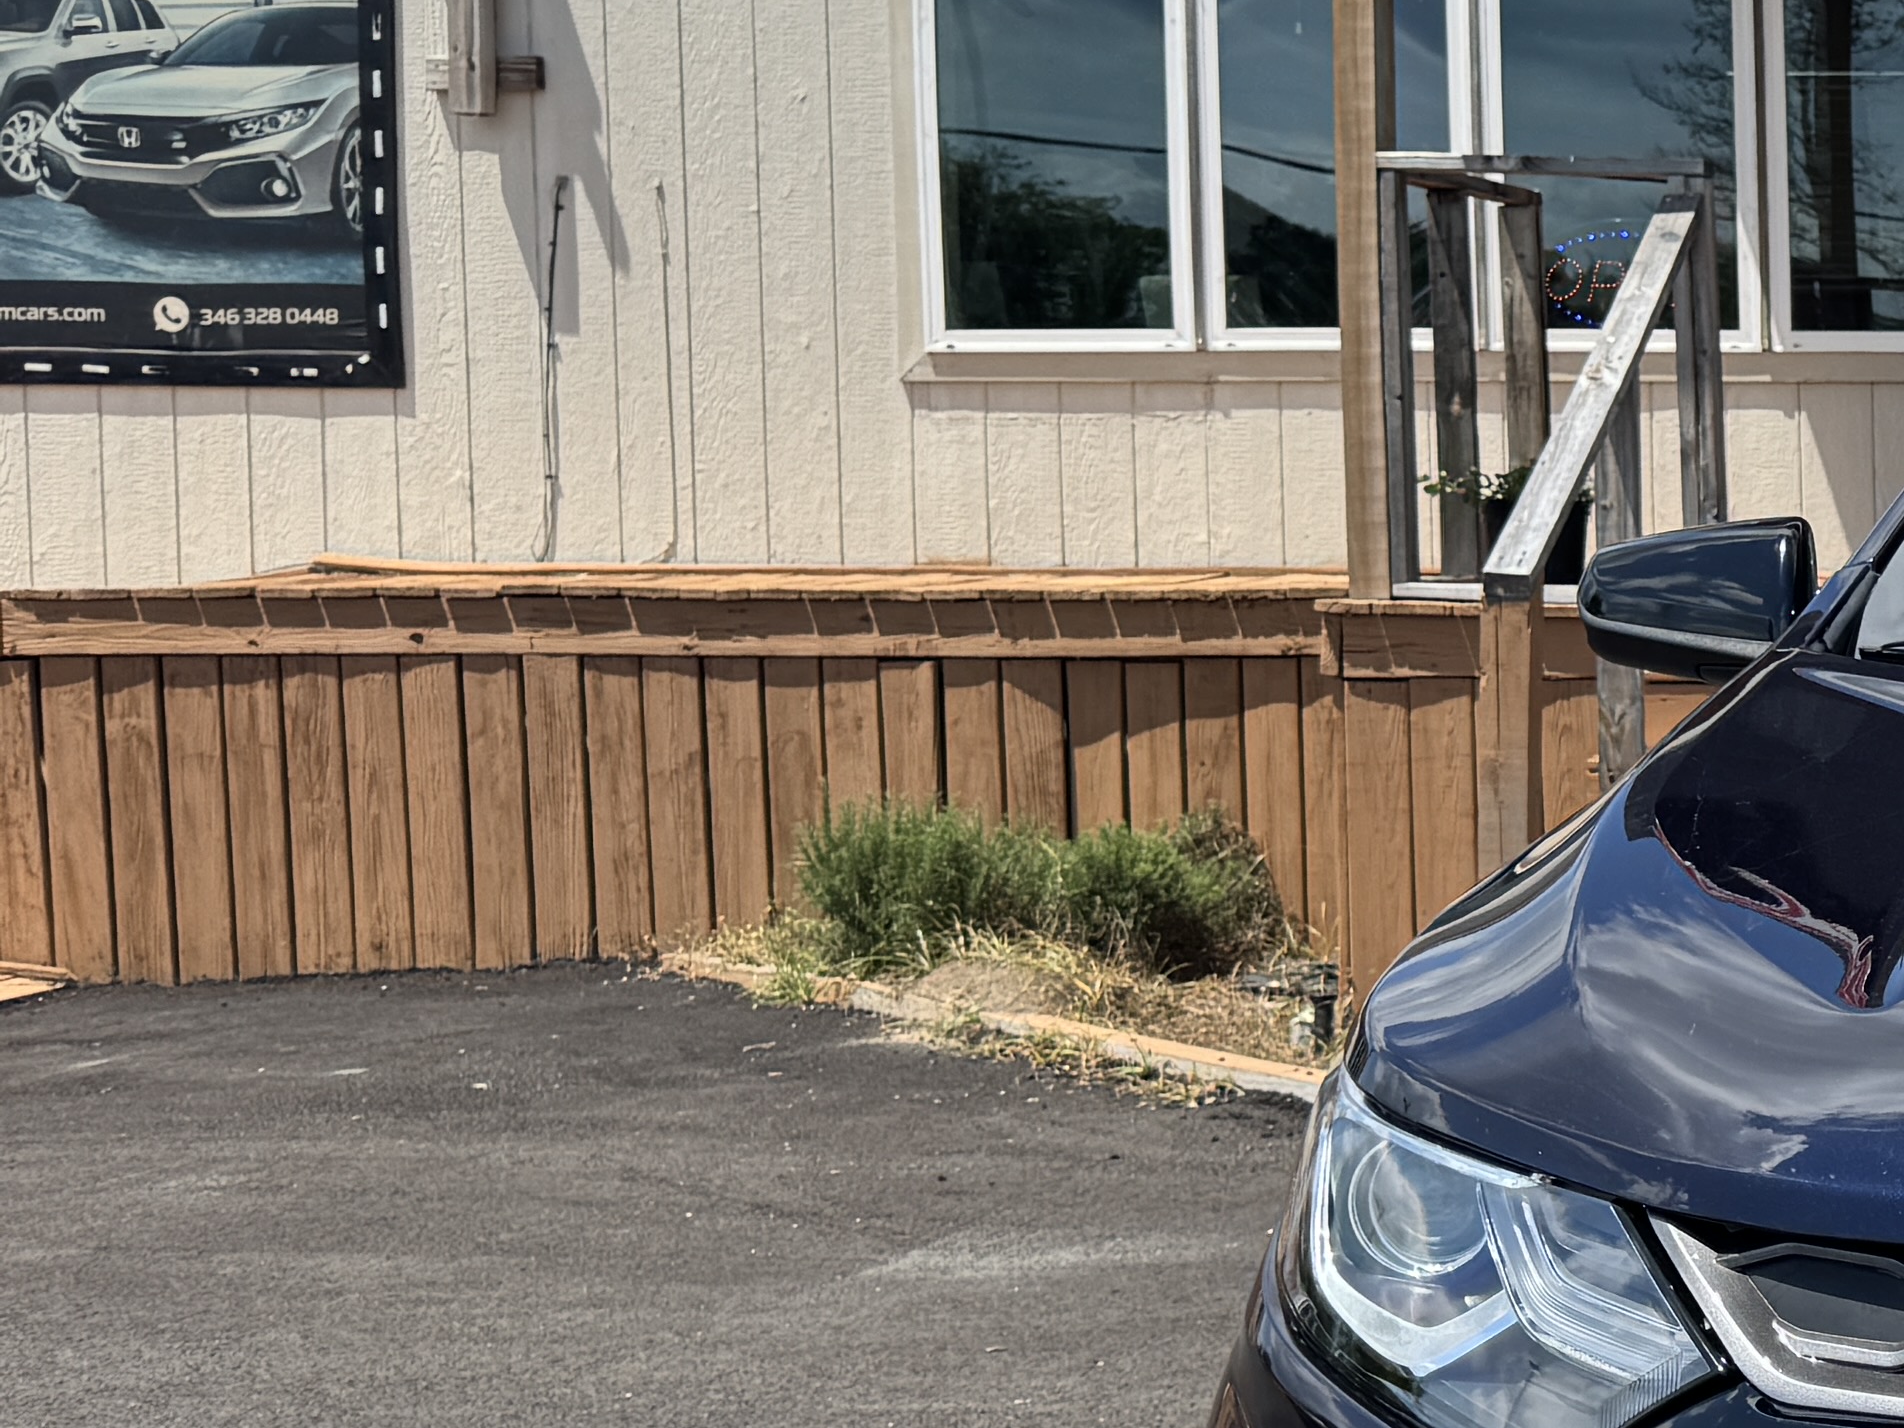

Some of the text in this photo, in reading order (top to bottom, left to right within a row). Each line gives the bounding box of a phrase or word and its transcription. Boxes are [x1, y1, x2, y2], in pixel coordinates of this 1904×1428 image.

[199, 307, 339, 326] 346 328 0448
